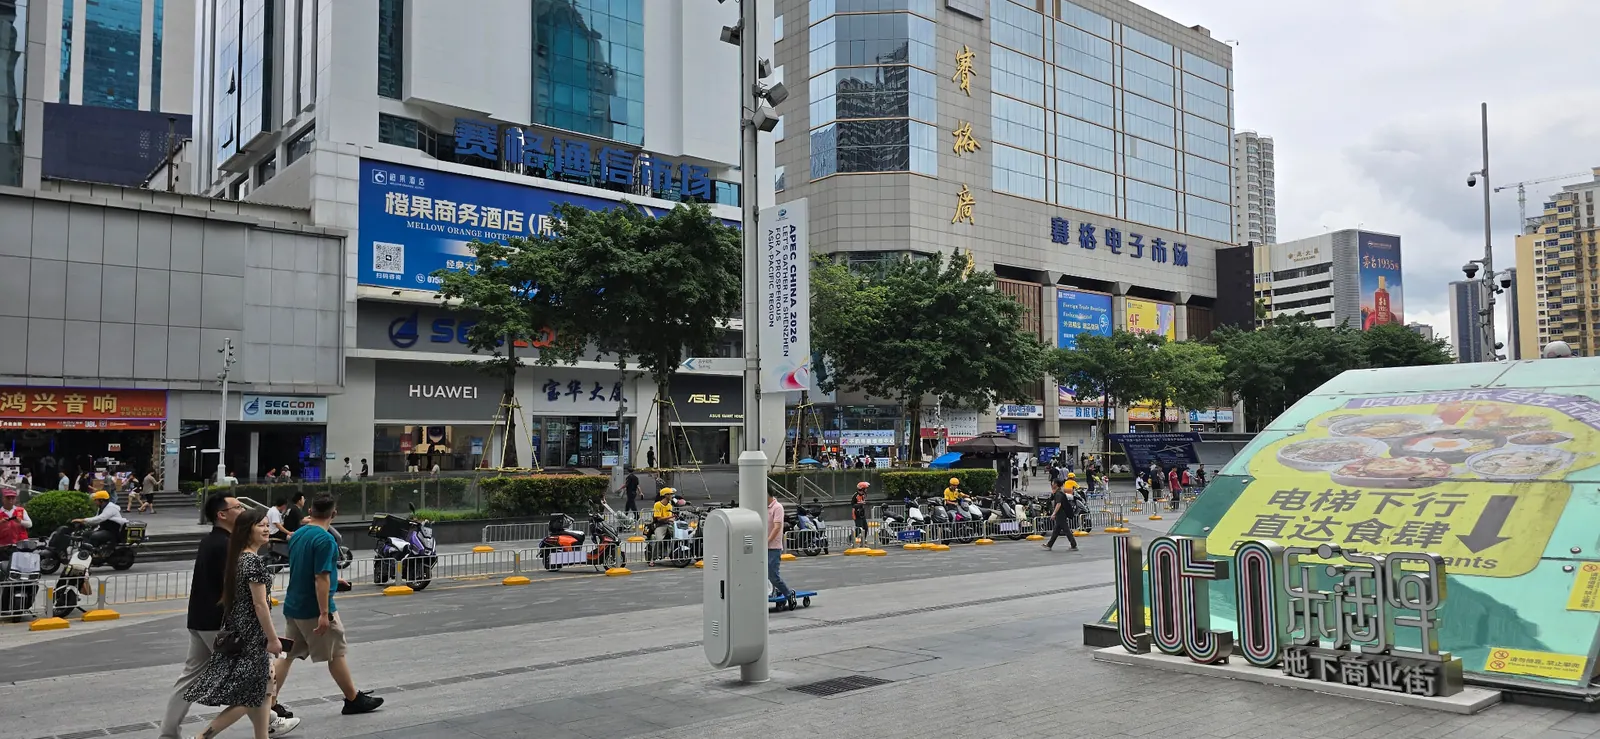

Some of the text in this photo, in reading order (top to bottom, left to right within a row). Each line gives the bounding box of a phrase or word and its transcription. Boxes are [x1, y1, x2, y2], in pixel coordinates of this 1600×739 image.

[454, 118, 711, 200] 赛格通信市场
[406, 221, 445, 232] MELLOW
[447, 227, 483, 238] ORANGE
[1051, 217, 1189, 267] 赛格电子市场
[789, 224, 798, 344] APEC CHINA 2026
[783, 293, 789, 304] IN
[1129, 313, 1139, 326] 4F
[0, 392, 118, 414] 鸿兴音响
[408, 384, 478, 399] HUAWEI
[687, 394, 720, 404] ASUS
[1267, 487, 1470, 518] 电梯下行
[1240, 513, 1451, 549] 直达食肆
[1282, 648, 1436, 698] 地下商业街
